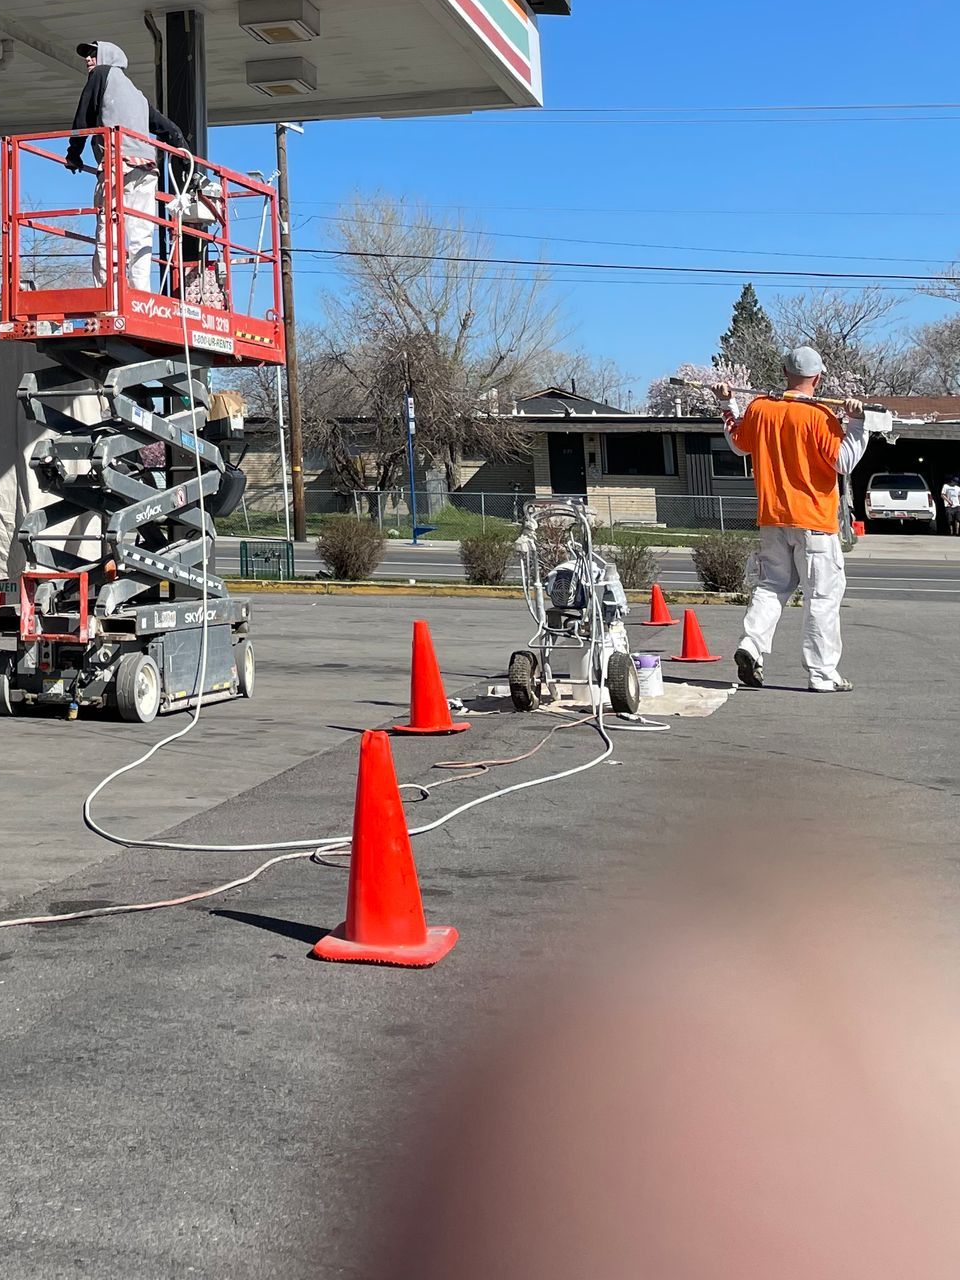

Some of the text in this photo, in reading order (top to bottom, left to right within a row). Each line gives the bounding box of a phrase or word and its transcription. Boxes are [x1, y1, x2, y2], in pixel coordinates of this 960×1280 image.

[131, 298, 172, 320] SKYJACK
[136, 504, 162, 523] SKYJACK
[184, 606, 217, 624] SKYJCK
